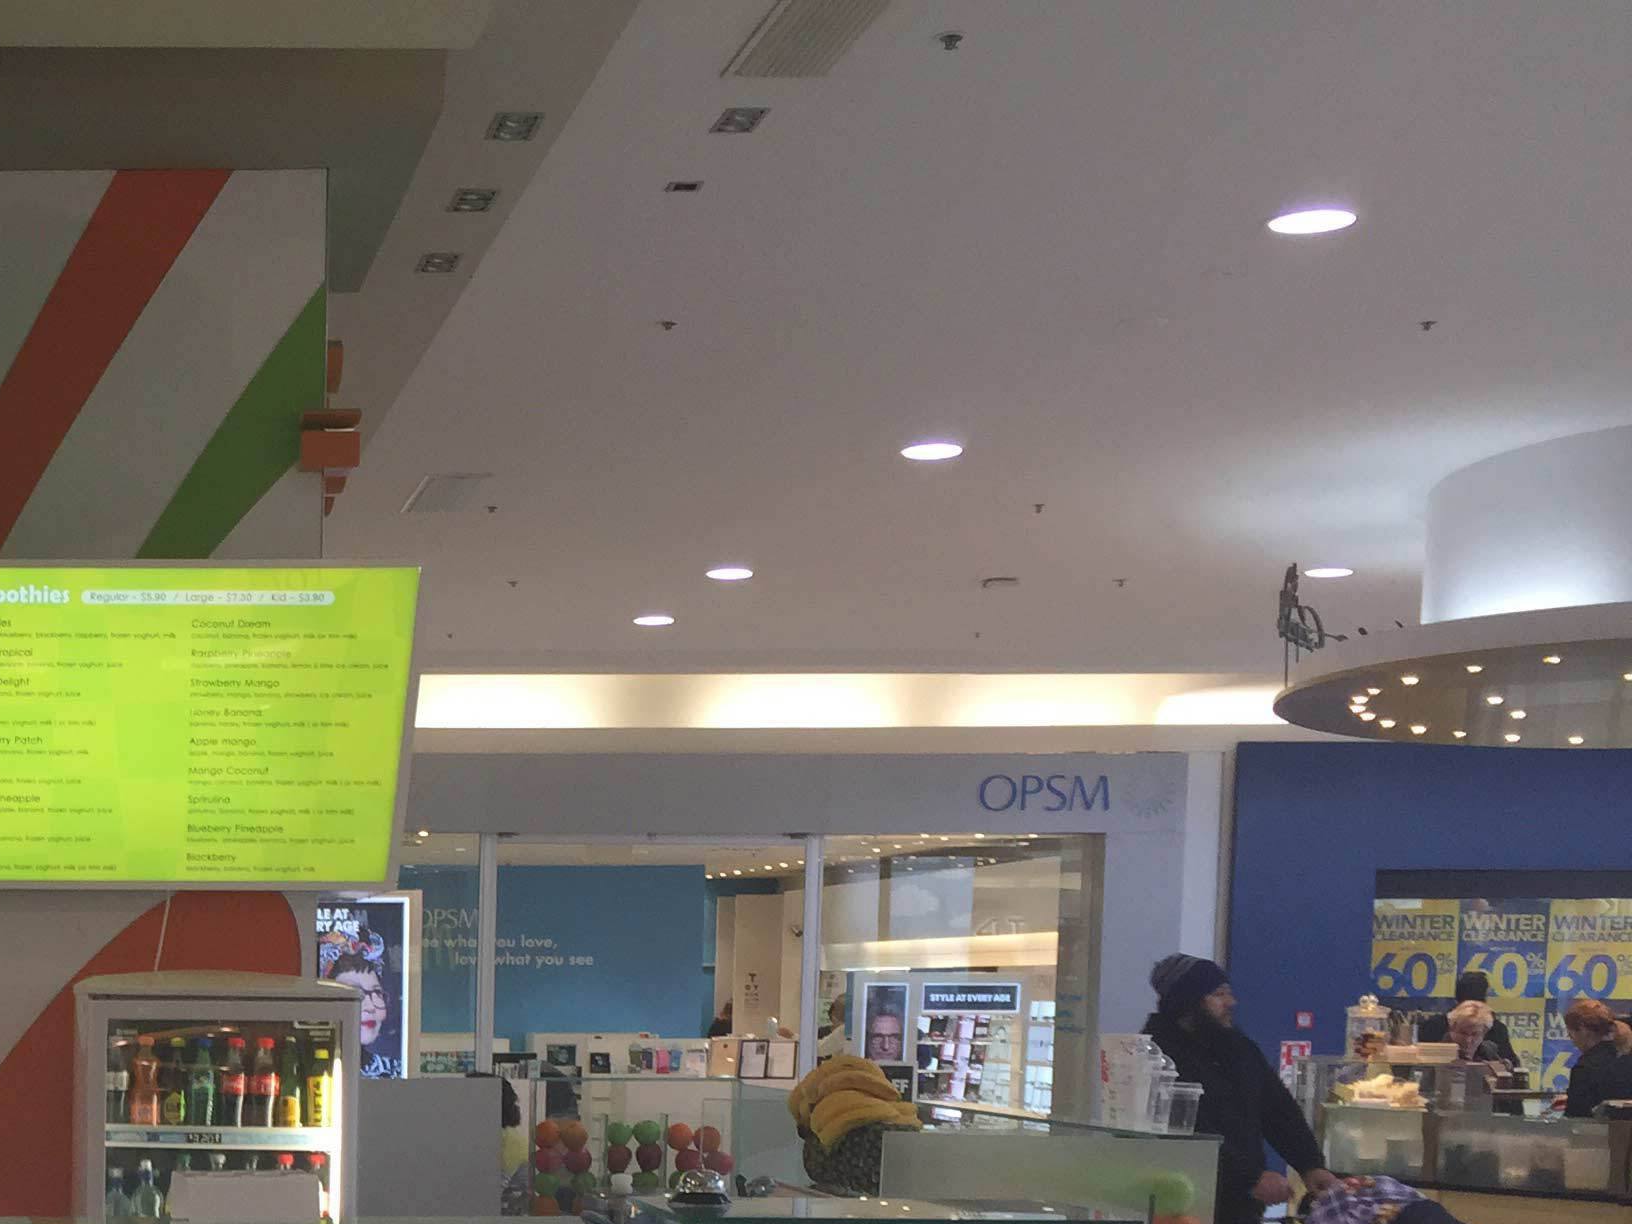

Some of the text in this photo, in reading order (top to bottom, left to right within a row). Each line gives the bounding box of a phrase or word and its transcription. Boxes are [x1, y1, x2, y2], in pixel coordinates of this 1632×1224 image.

[89, 592, 129, 604] Regular
[185, 592, 214, 604] Large
[271, 592, 287, 604] Kid
[191, 619, 234, 629] Coconut
[189, 678, 280, 689] Strawberry Mango
[223, 708, 262, 718] Banana
[14, 735, 43, 745] Patch
[189, 737, 257, 748] Apple mango
[188, 766, 270, 777] Mango Coconut
[979, 774, 1110, 812] OPSM
[187, 824, 284, 834] Blueberry Pineapple
[186, 853, 237, 863] Blackberry
[333, 908, 350, 920] AT
[330, 920, 360, 933] AGE
[1374, 914, 1455, 930] WINTER
[1464, 913, 1545, 930] WINTER
[1374, 930, 1455, 941] CLEARANCE
[1464, 930, 1545, 942] CLEARANCE
[444, 933, 478, 948] wha
[520, 934, 558, 950] love,
[455, 953, 594, 969] lov what you see
